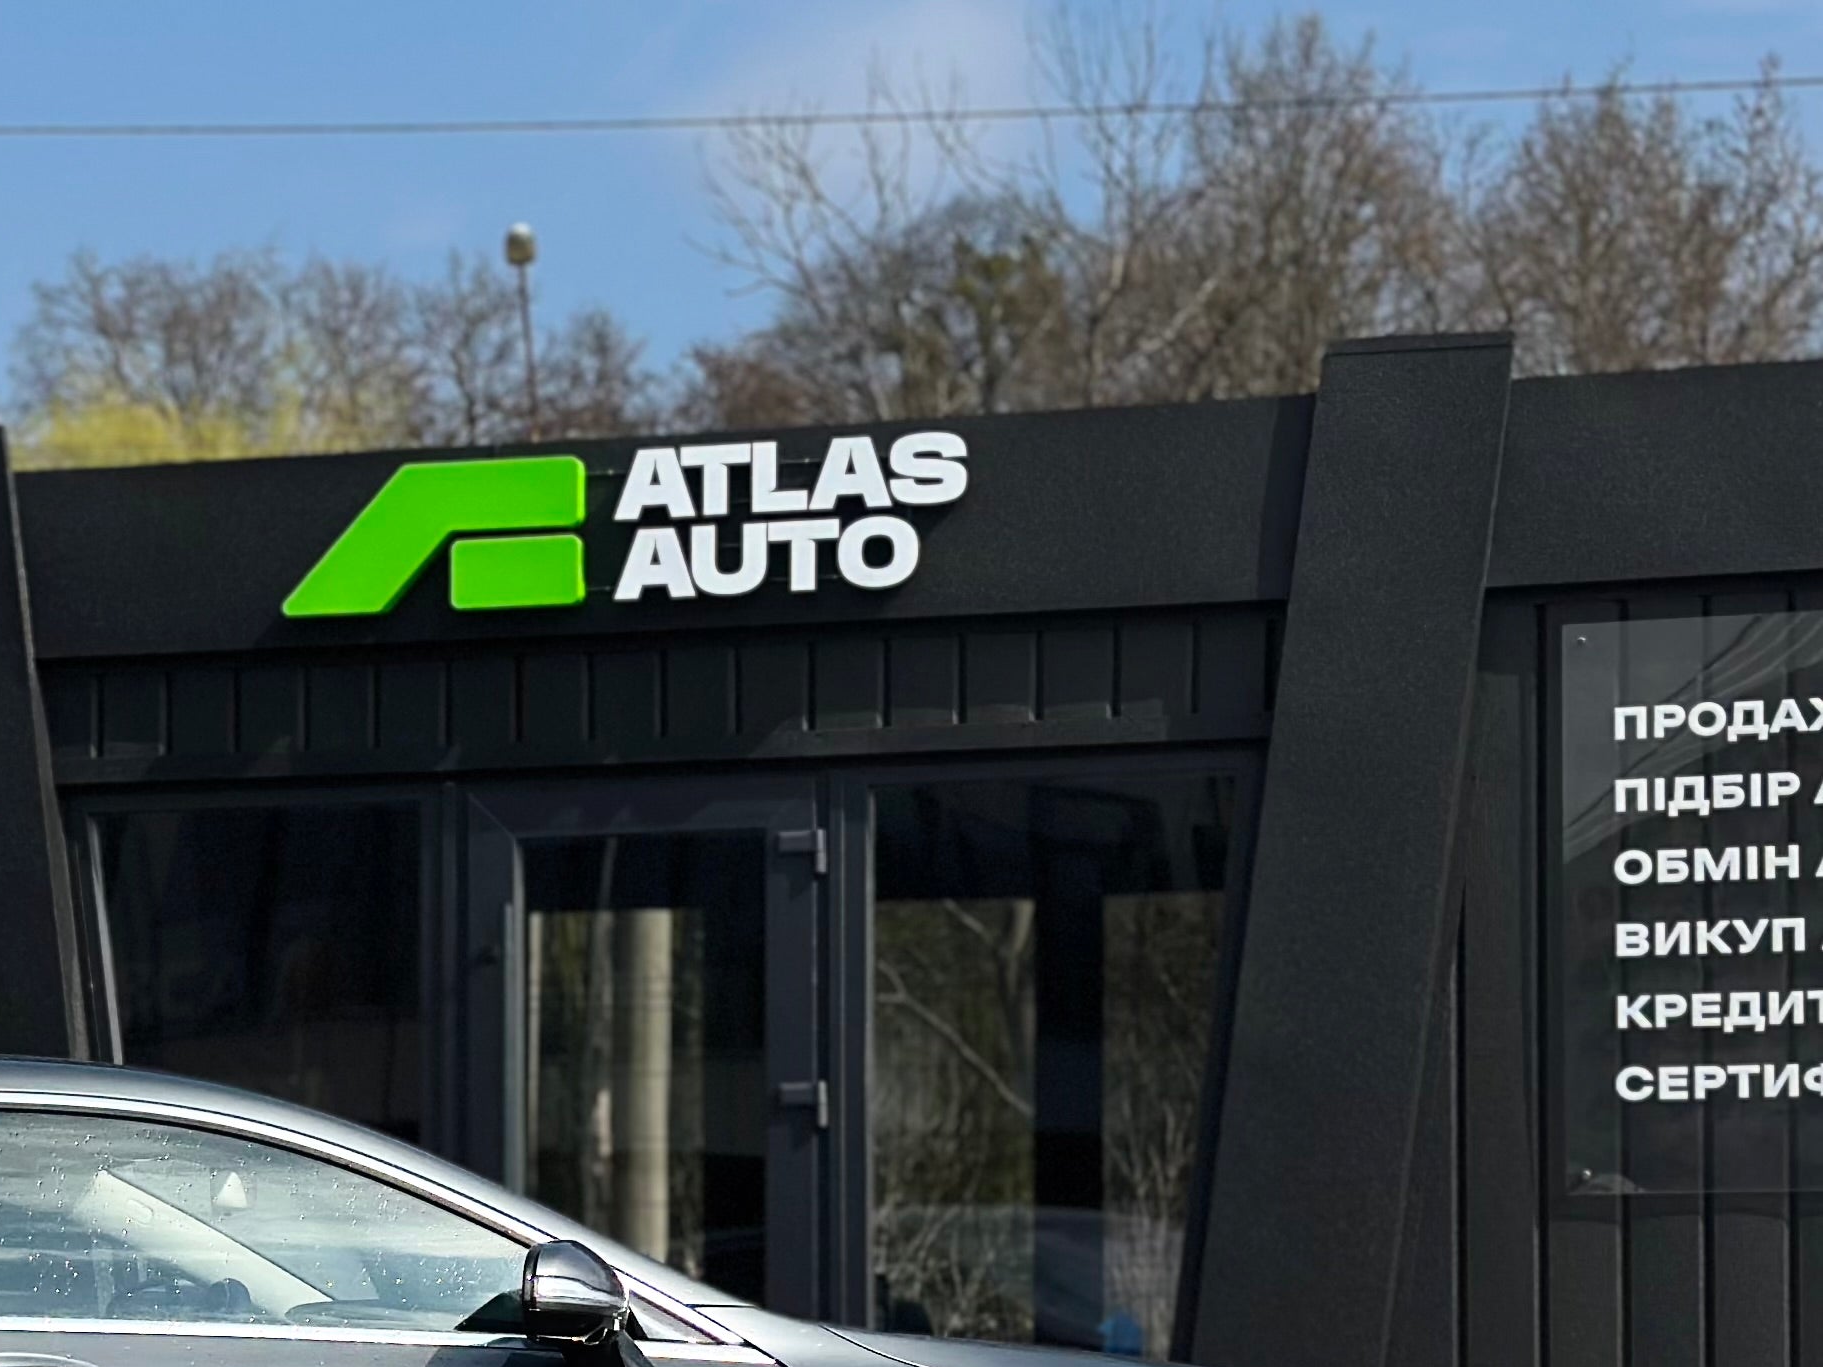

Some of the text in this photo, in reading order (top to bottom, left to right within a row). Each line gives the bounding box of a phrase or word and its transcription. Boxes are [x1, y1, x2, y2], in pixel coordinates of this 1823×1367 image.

[613, 432, 969, 521] ATLAS
[613, 515, 920, 601] AUTO
[1613, 771, 1801, 818] ПІДБІР
[1613, 844, 1800, 885] ОБМІН
[1615, 917, 1806, 957] ВИКУП
